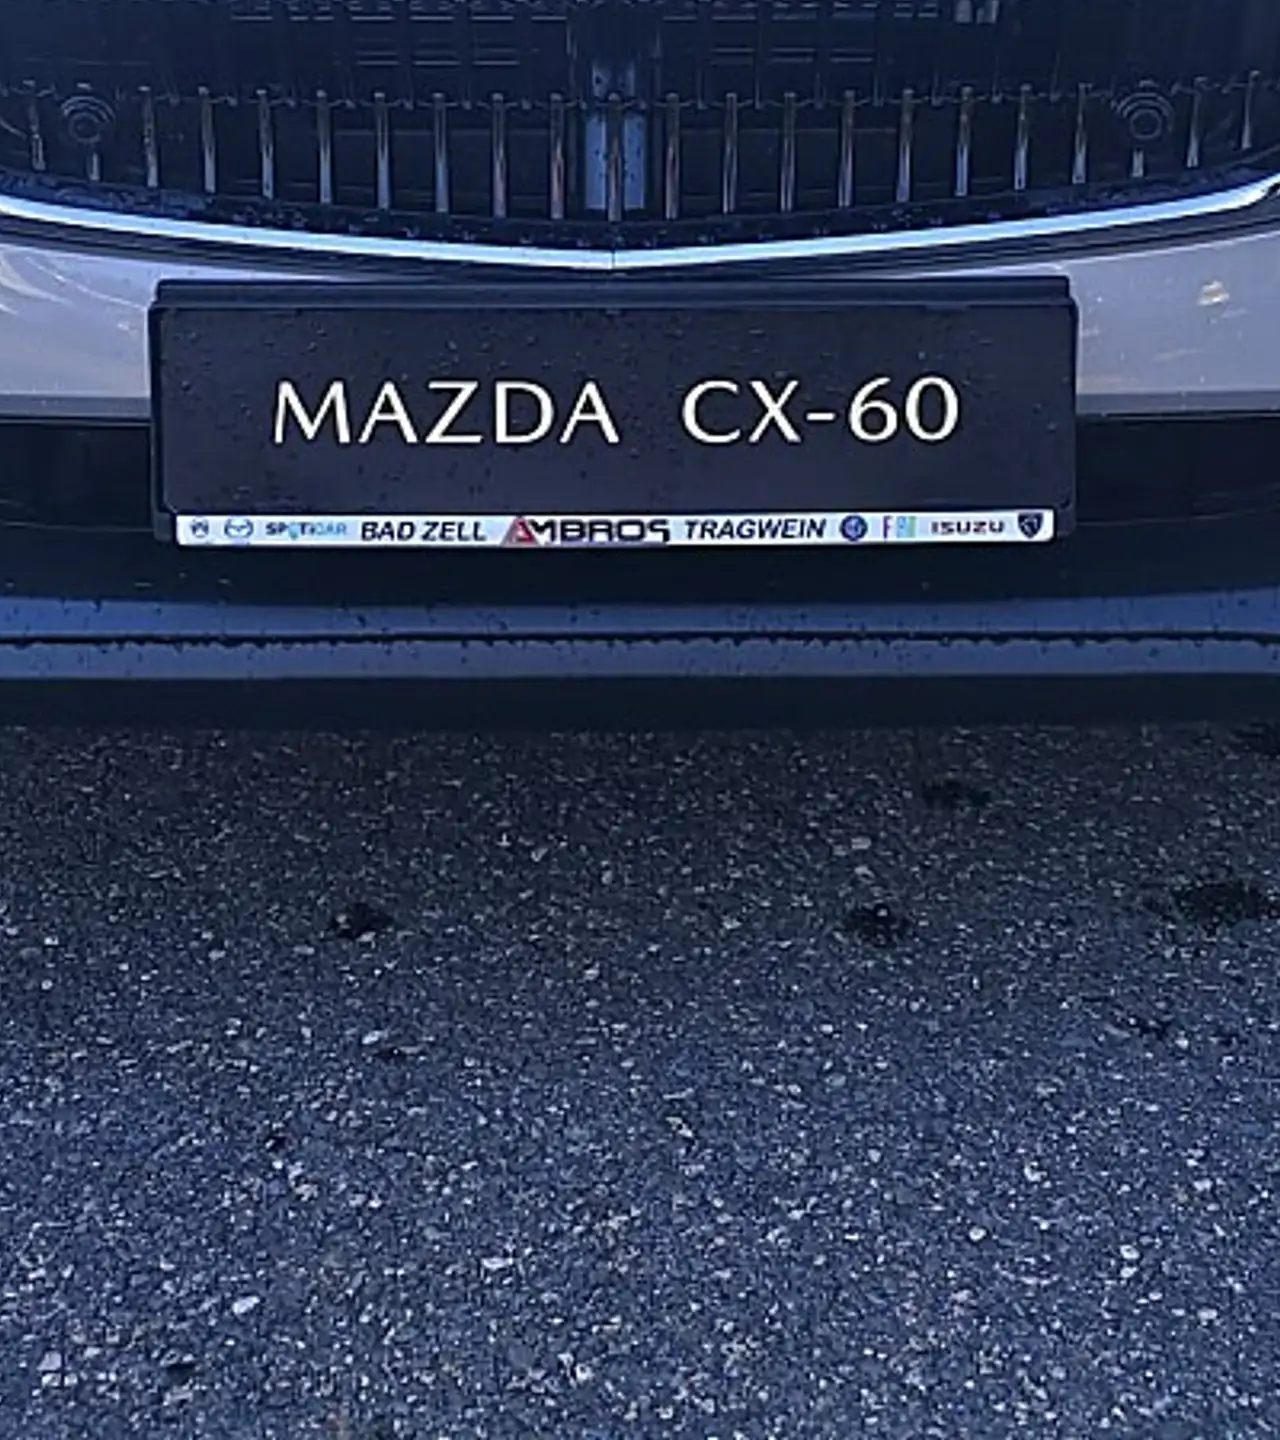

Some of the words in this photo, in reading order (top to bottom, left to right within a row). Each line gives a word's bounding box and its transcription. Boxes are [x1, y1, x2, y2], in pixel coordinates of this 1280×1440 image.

[273, 380, 619, 445] MAZDA
[681, 376, 961, 444] CX-60
[360, 521, 415, 542] BAD
[420, 521, 488, 543] ZELL
[684, 518, 827, 540] TRAGWEIN
[931, 521, 1005, 536] ISUZU
